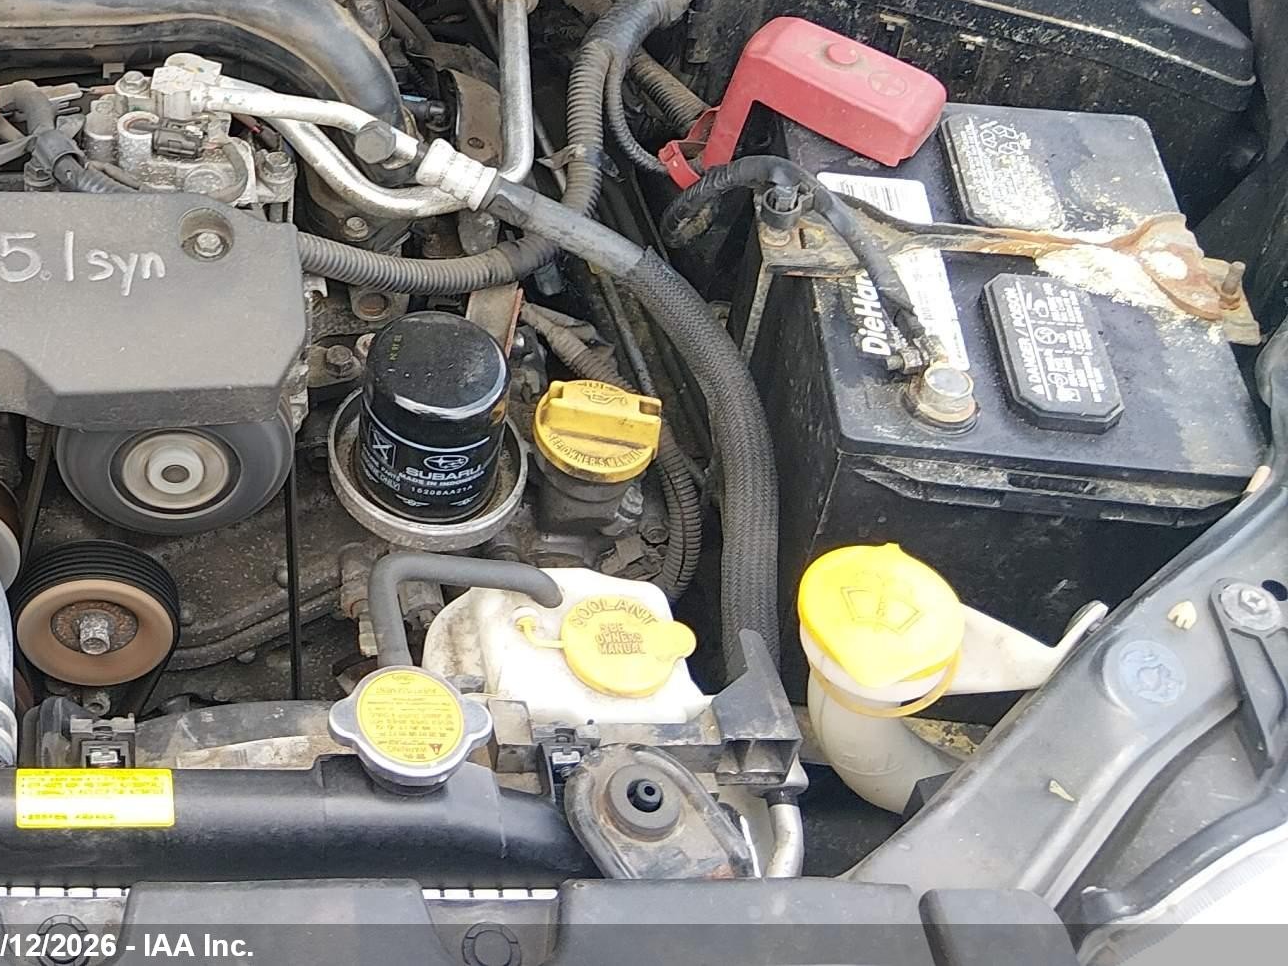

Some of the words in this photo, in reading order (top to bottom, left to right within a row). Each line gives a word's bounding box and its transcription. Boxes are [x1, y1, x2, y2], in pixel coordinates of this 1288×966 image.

[851, 268, 892, 357] DieHar
[398, 471, 426, 487] MADE
[403, 464, 485, 481] SUBARU
[569, 597, 659, 629] COOLANT
[599, 622, 625, 633] SEE
[598, 641, 647, 656] MANUAL
